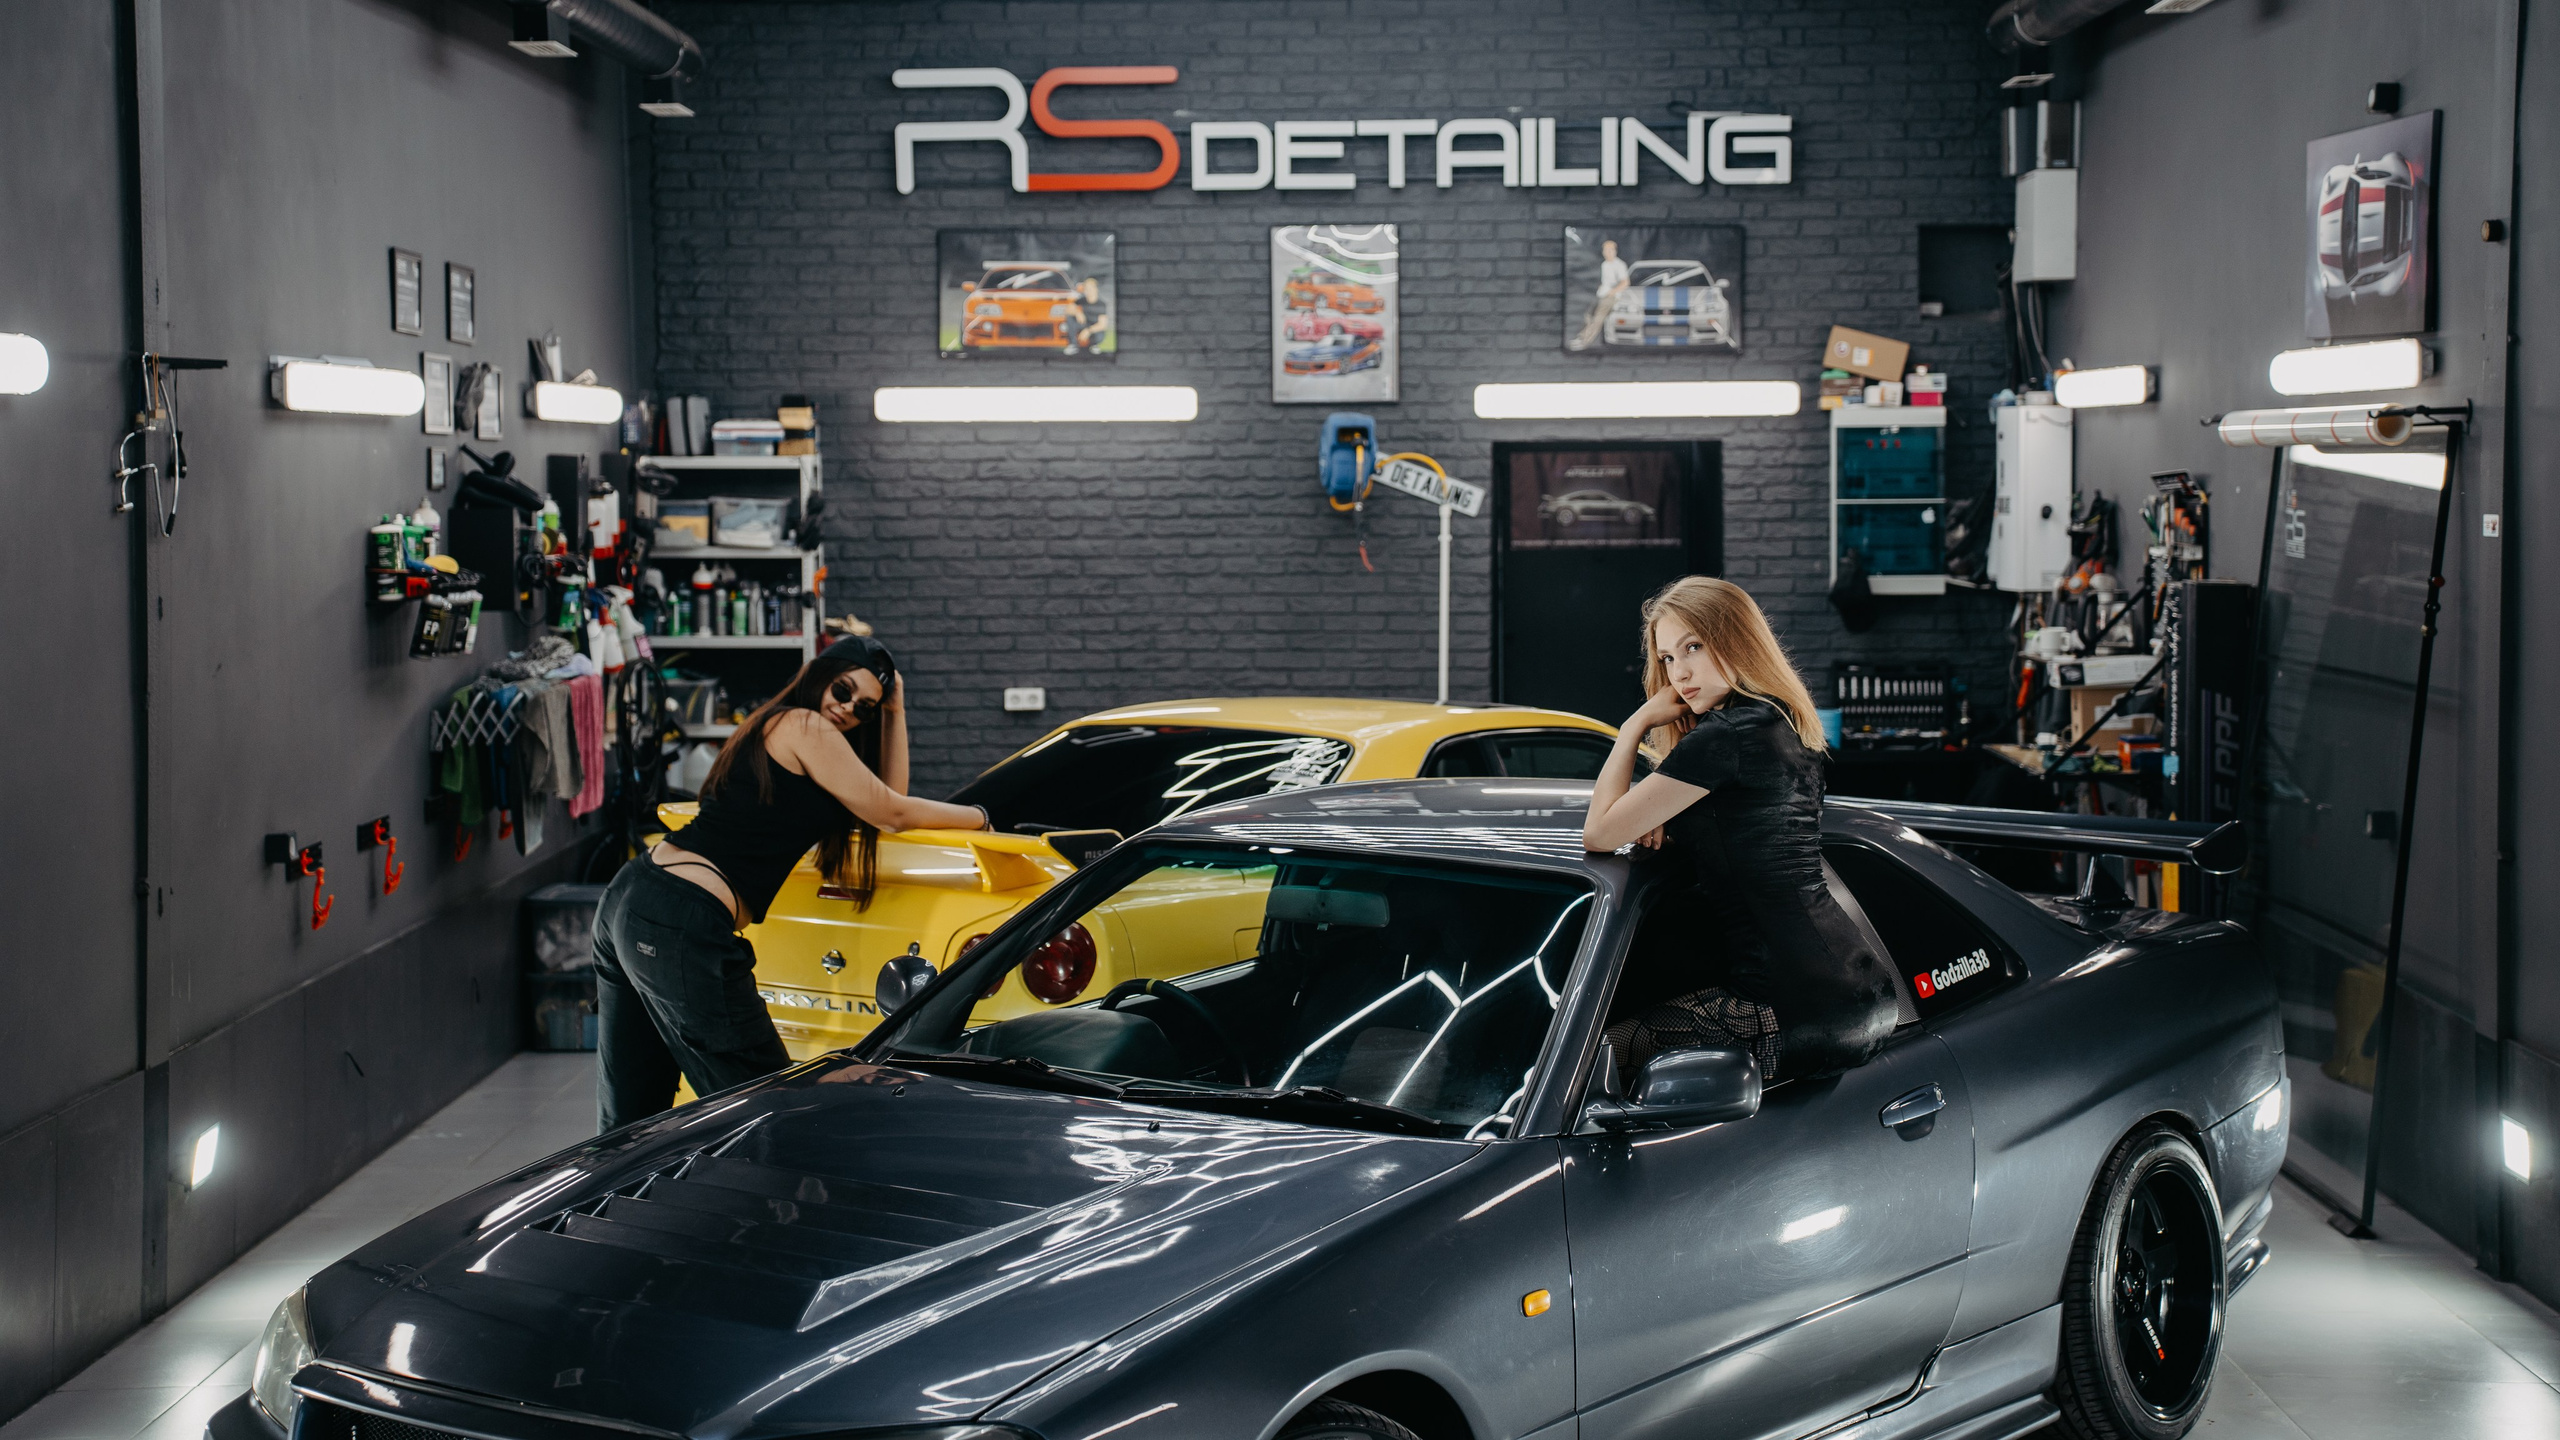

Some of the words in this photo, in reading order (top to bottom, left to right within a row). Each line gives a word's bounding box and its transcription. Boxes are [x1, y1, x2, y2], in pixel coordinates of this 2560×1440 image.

[892, 65, 1180, 195] RS
[1191, 112, 1793, 191] DETAILING
[1084, 849, 1111, 860] nis
[1931, 948, 1991, 991] Godzilla38
[758, 989, 877, 1016] SKYLIN
